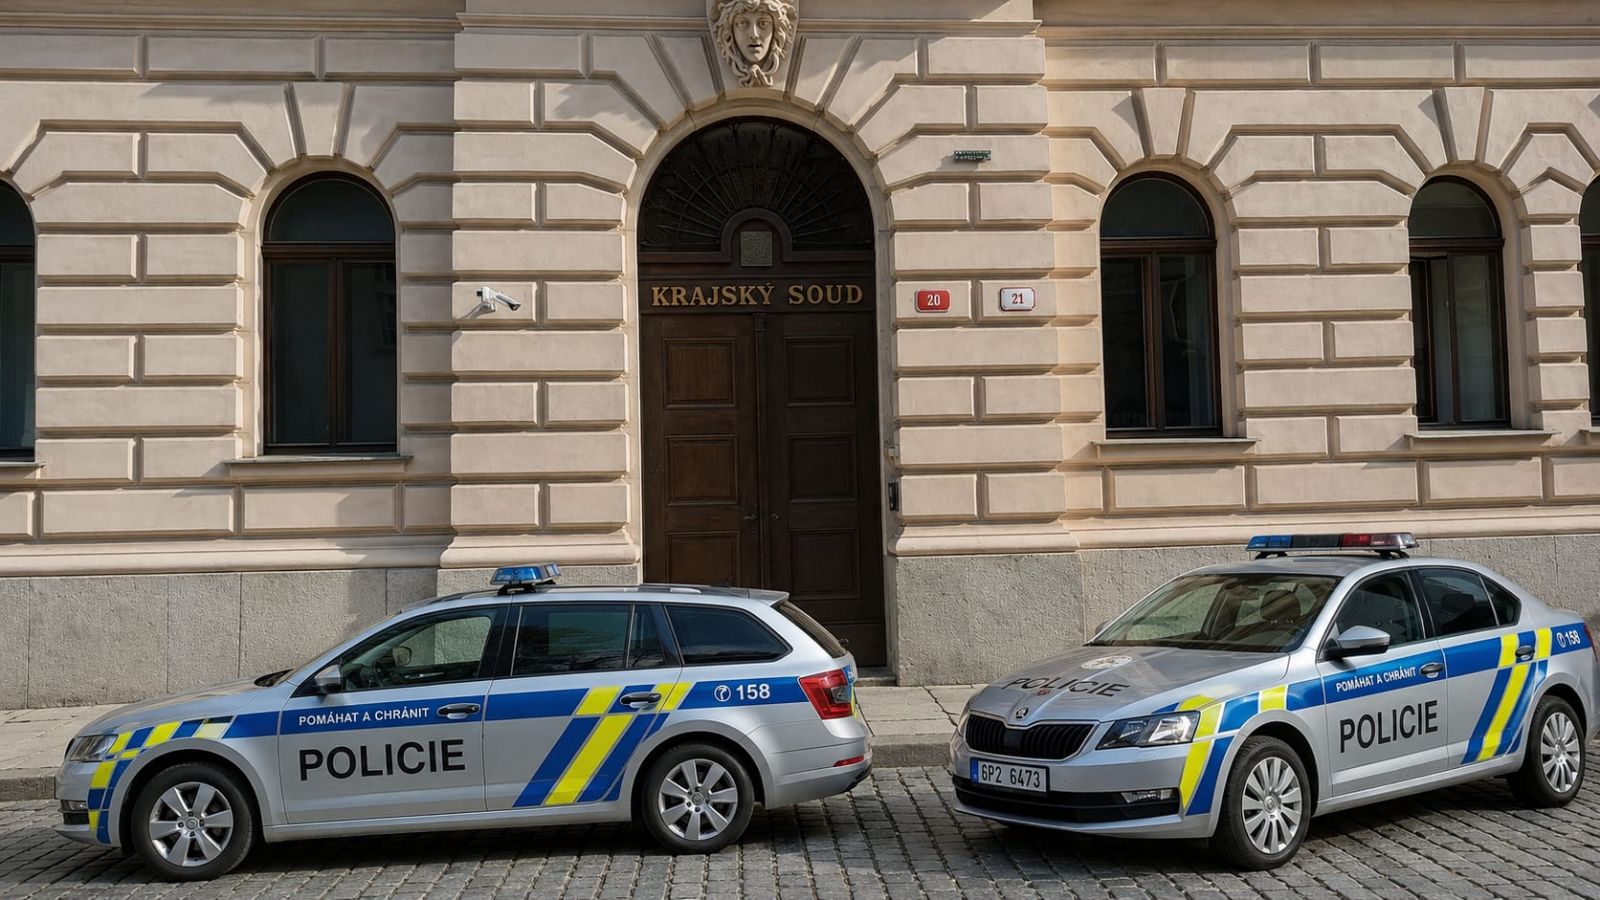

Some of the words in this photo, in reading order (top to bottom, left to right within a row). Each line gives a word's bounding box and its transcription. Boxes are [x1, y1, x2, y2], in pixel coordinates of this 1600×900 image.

[651, 282, 775, 306] KRAJSKÝ
[788, 284, 863, 305] SOUD
[927, 293, 941, 306] 20
[1011, 293, 1024, 305] 21
[1565, 630, 1581, 646] 158
[1001, 677, 1130, 697] POLICIE
[1336, 675, 1375, 693] POMÁHAT
[1376, 673, 1384, 684] A
[1384, 665, 1417, 683] CHRÁNIT
[735, 683, 771, 701] 158
[298, 711, 359, 726] POMÁHAT
[362, 711, 372, 722] A
[374, 705, 430, 721] CHRÁNIT
[1340, 700, 1439, 754] POLICIE
[299, 738, 466, 782] POLICIE
[981, 763, 1002, 784] 6P2
[1009, 768, 1041, 788] 6473
